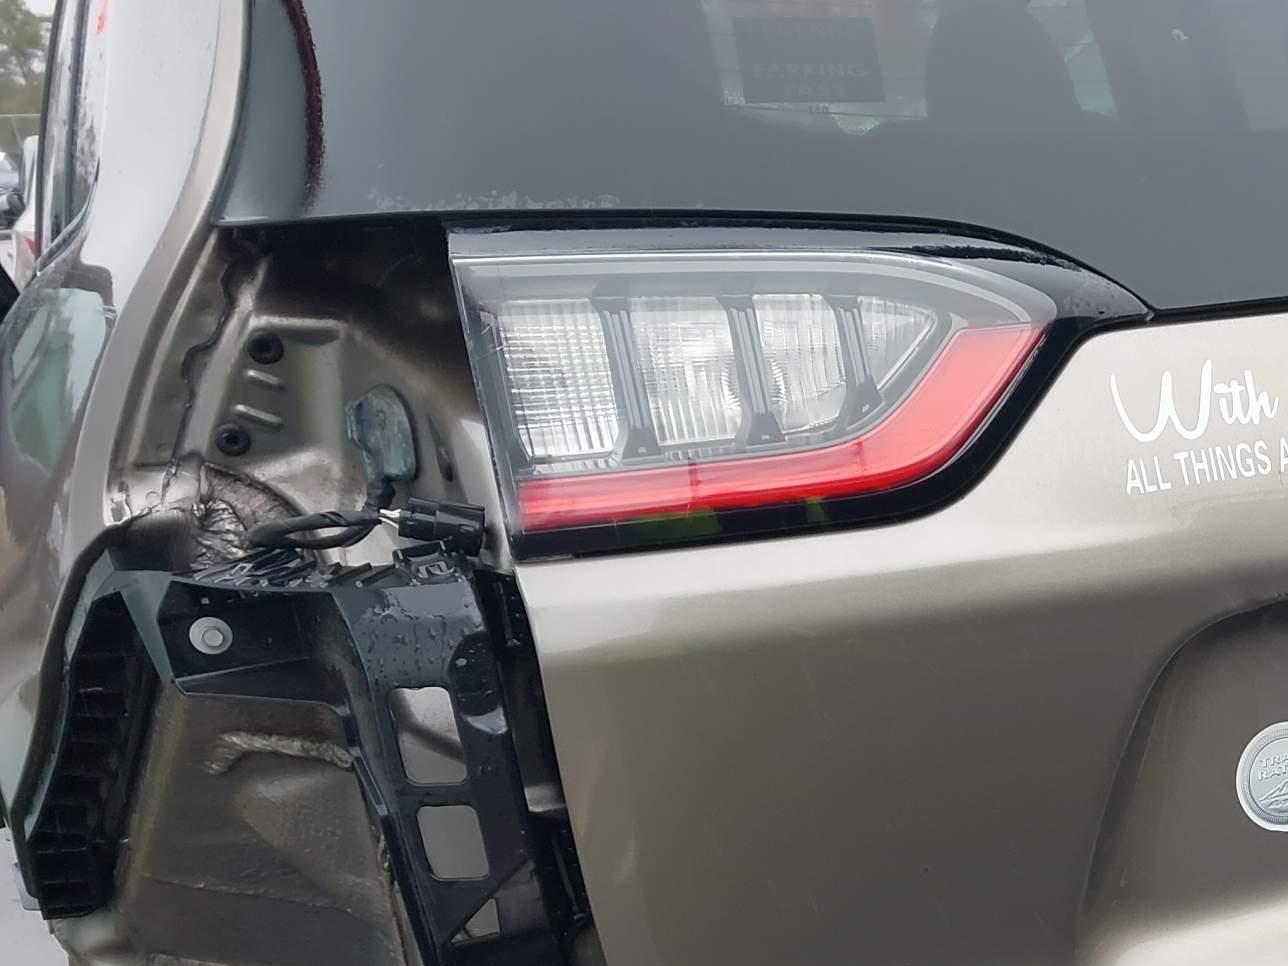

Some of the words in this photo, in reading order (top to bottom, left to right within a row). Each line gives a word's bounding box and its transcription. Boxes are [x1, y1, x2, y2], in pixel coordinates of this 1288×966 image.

[1110, 359, 1279, 442] With
[1126, 455, 1172, 494] ALL
[1174, 440, 1272, 486] THINGS
